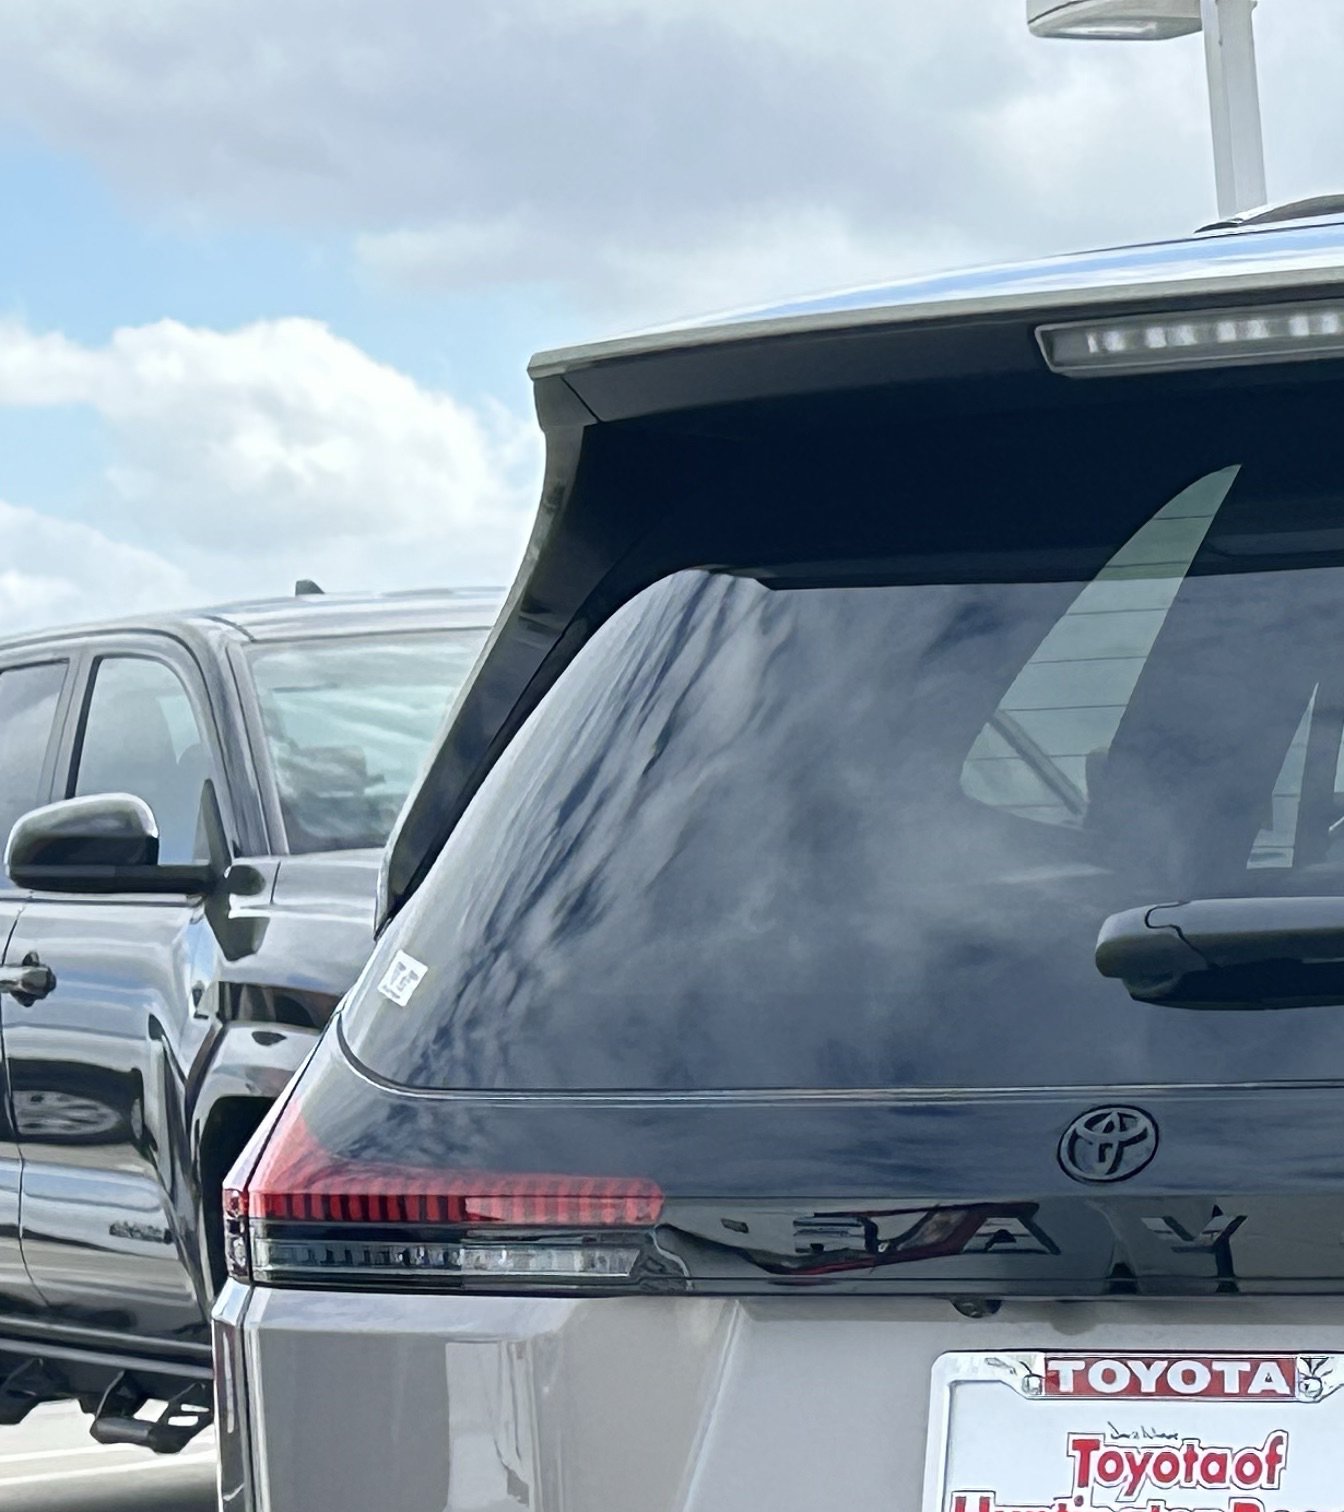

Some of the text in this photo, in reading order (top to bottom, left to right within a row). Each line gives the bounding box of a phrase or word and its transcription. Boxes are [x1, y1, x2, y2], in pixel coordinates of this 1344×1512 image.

[1047, 1359, 1290, 1395] TOYOTA
[1072, 1435, 1286, 1497] Toyota of
